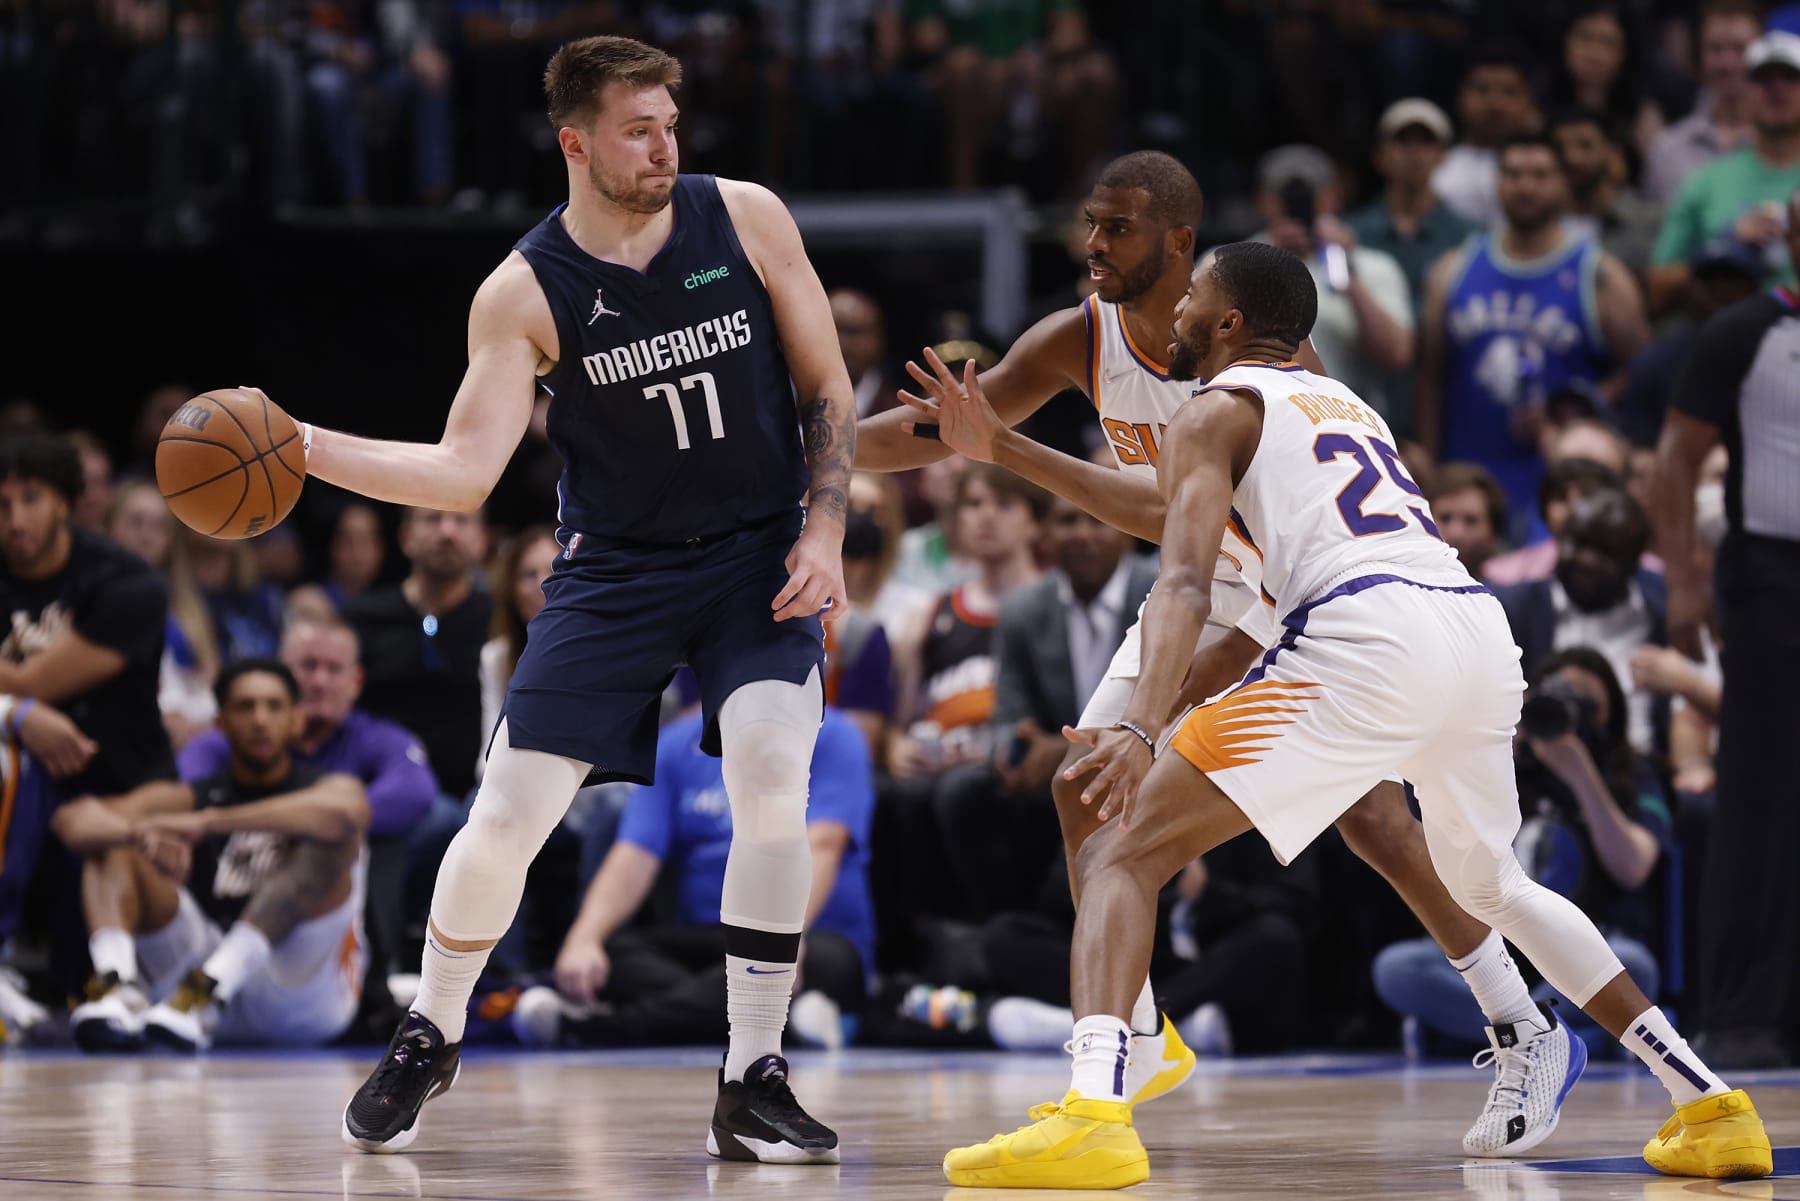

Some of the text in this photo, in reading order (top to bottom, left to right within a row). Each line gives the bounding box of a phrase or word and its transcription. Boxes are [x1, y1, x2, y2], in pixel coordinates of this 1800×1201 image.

[684, 265, 730, 290] chime
[582, 309, 752, 386] MAVERICKS
[642, 371, 725, 450] 77
[1312, 431, 1445, 542] 25
